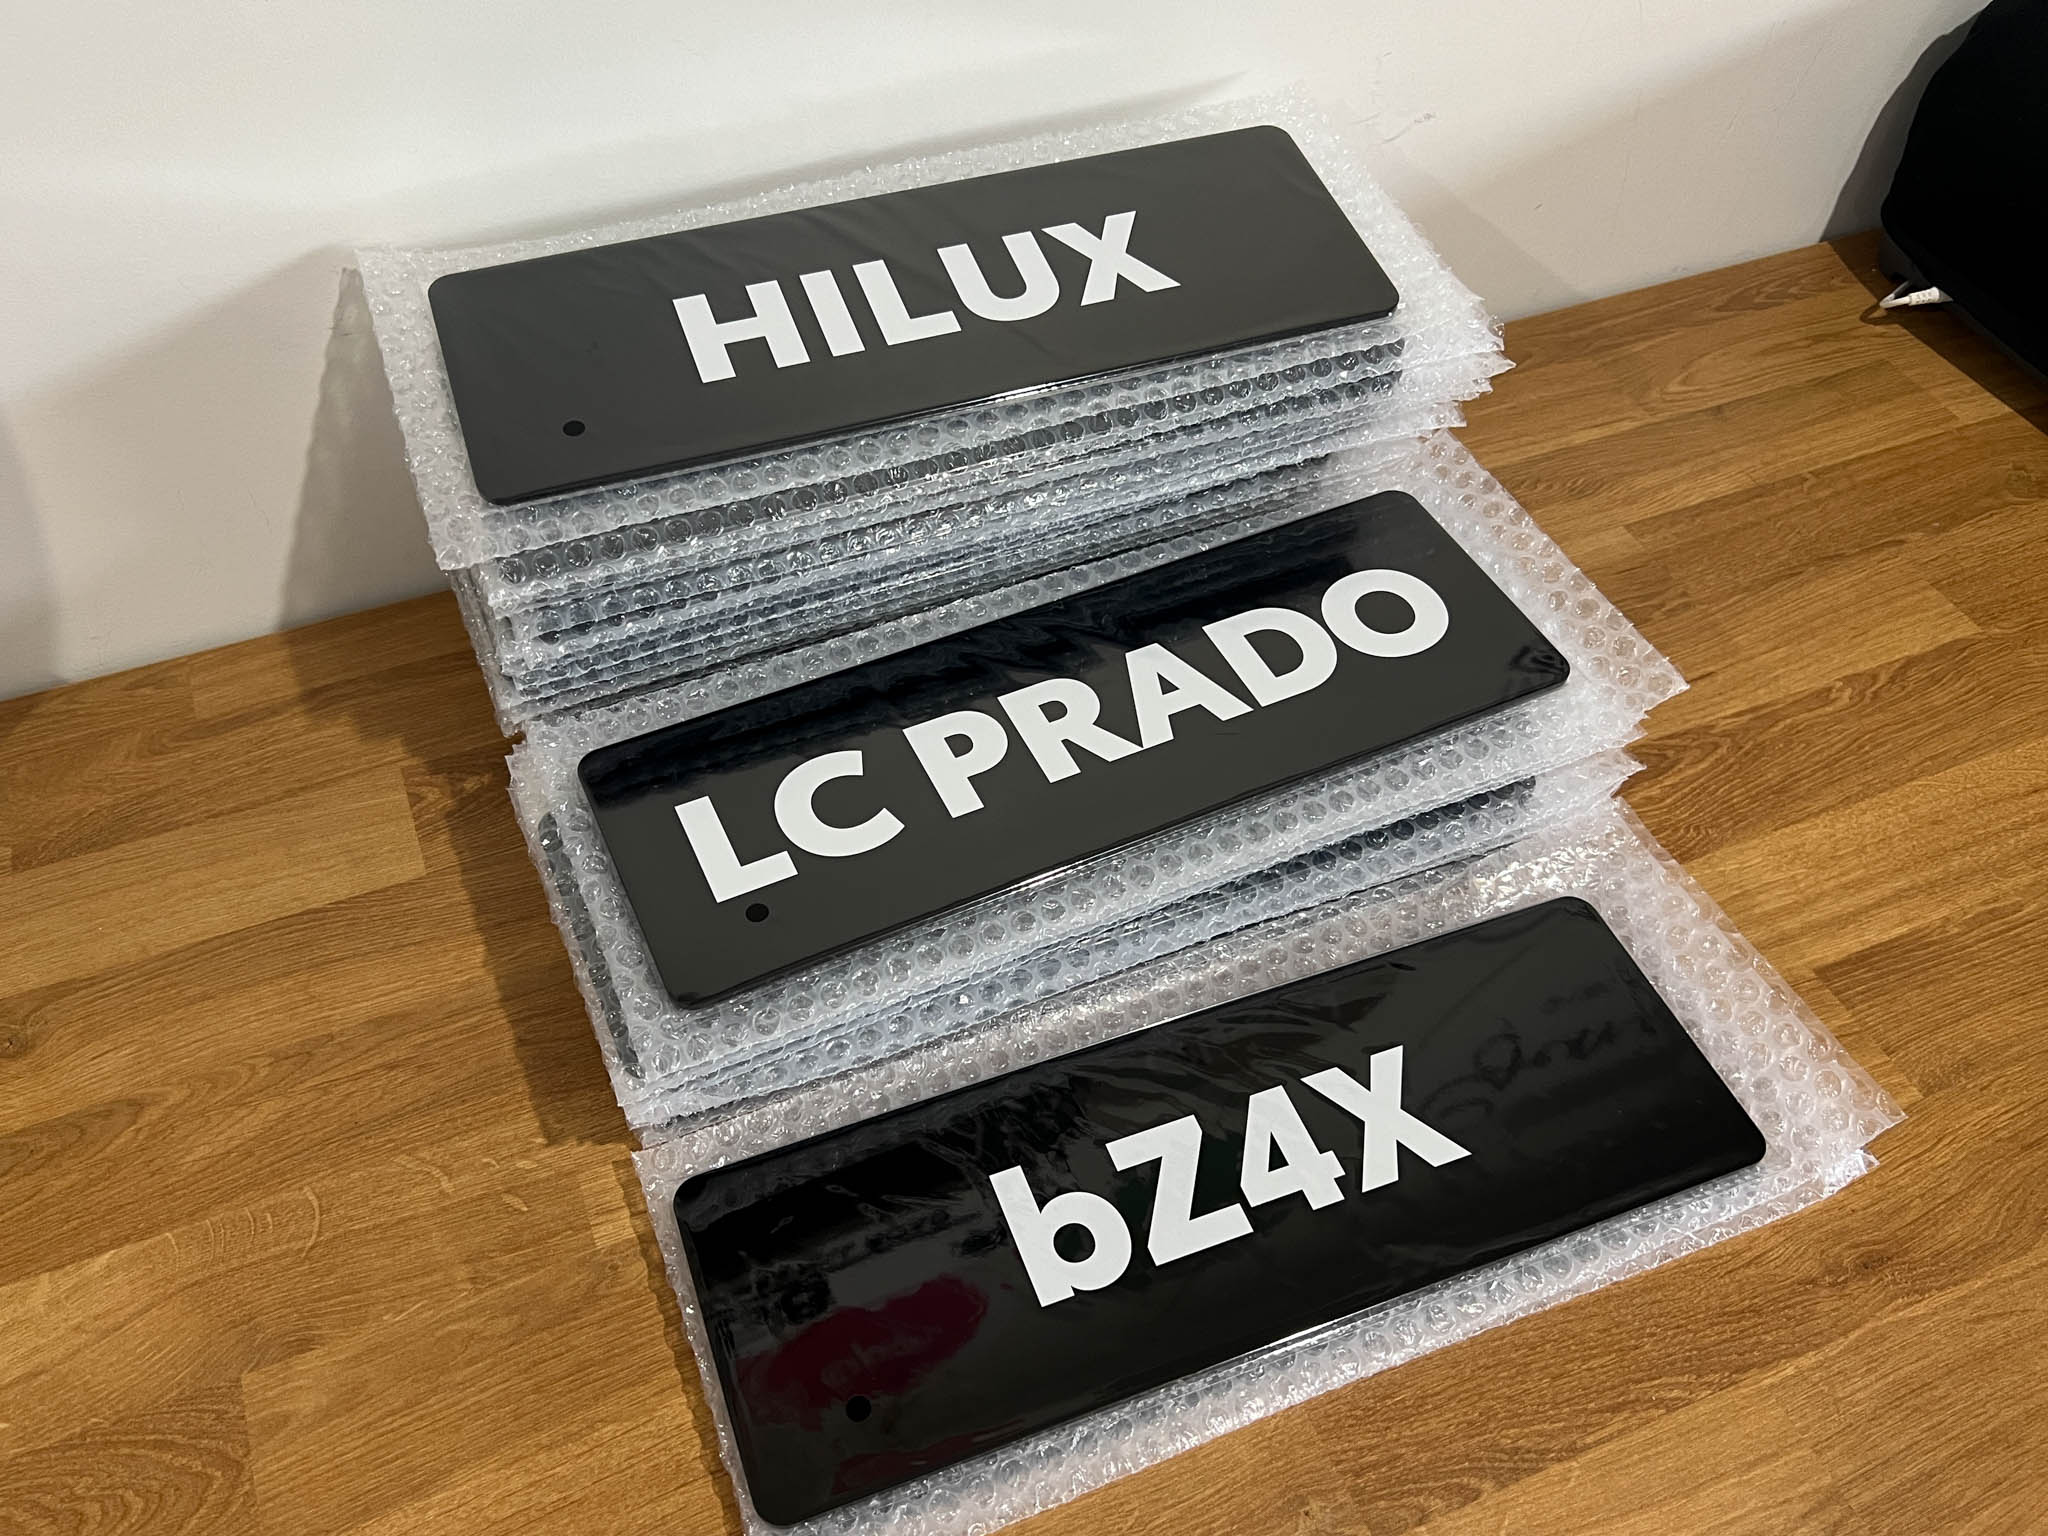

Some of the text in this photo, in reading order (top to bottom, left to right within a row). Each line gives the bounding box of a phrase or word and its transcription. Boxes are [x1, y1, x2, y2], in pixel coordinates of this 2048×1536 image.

[673, 211, 1180, 383] HILUX
[675, 569, 1449, 903] LC PRADO
[989, 1045, 1471, 1307] bZ4X
